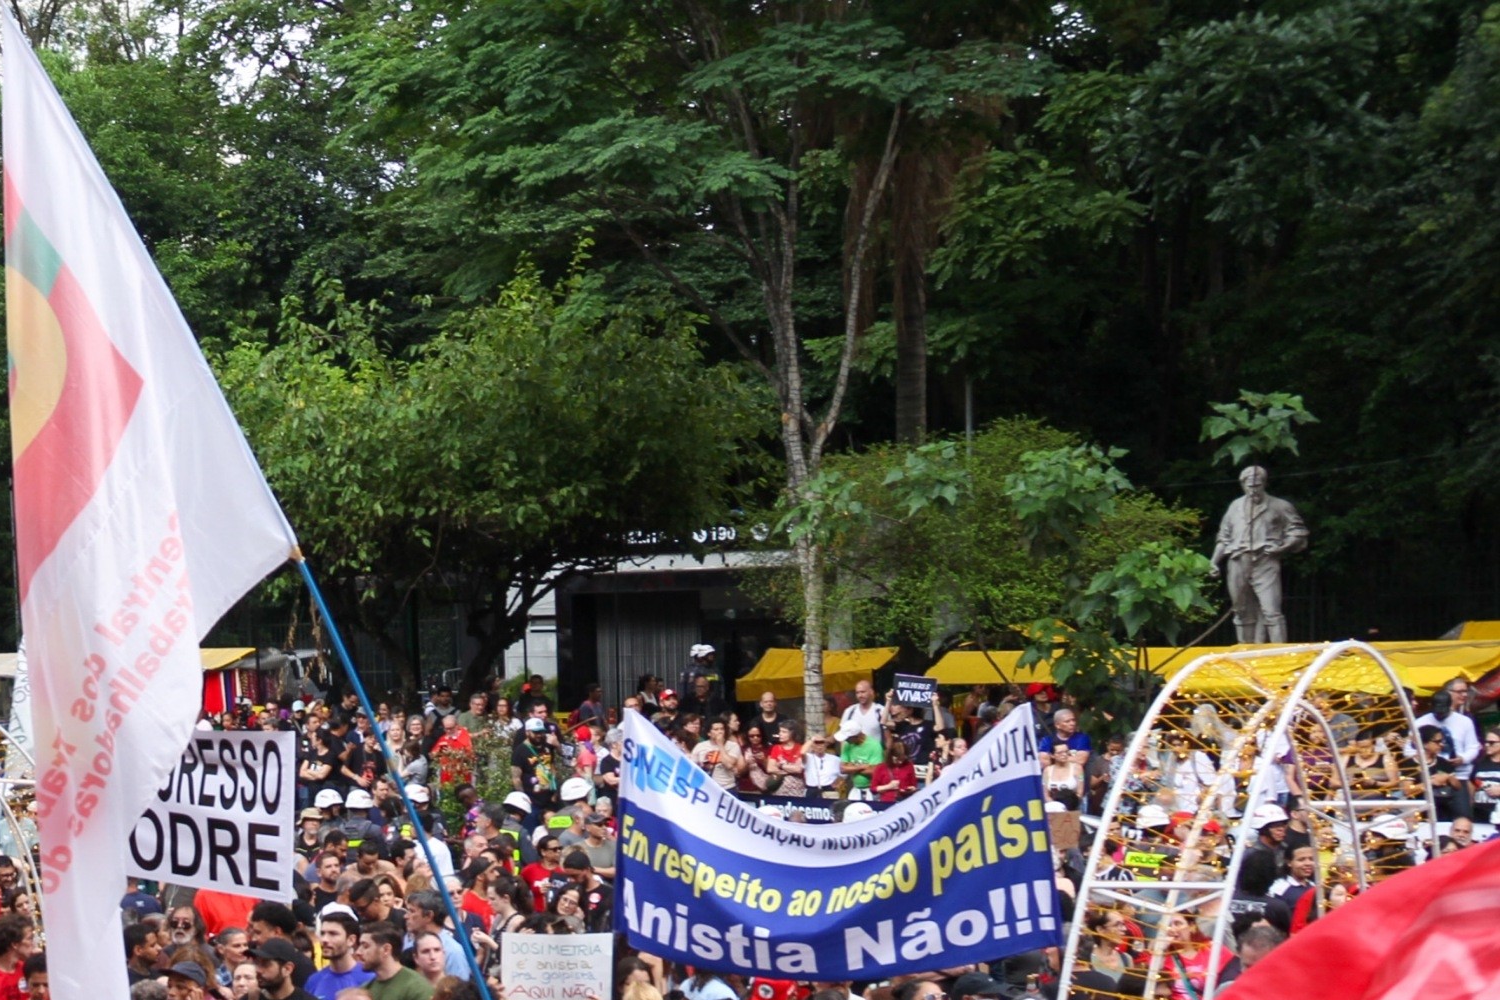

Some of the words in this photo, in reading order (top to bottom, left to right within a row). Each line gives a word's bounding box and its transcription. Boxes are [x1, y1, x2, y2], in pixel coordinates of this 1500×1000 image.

[896, 689, 933, 703] VIVAS!
[623, 737, 710, 806] SINESP
[988, 723, 1038, 775] LUTA
[653, 841, 783, 915] respeito
[786, 888, 823, 918] ao
[825, 851, 919, 915] nosso
[928, 794, 1049, 897] país:
[623, 877, 819, 974] Anistia
[843, 878, 1057, 972] Não!!!
[508, 984, 556, 1000] AQUI
